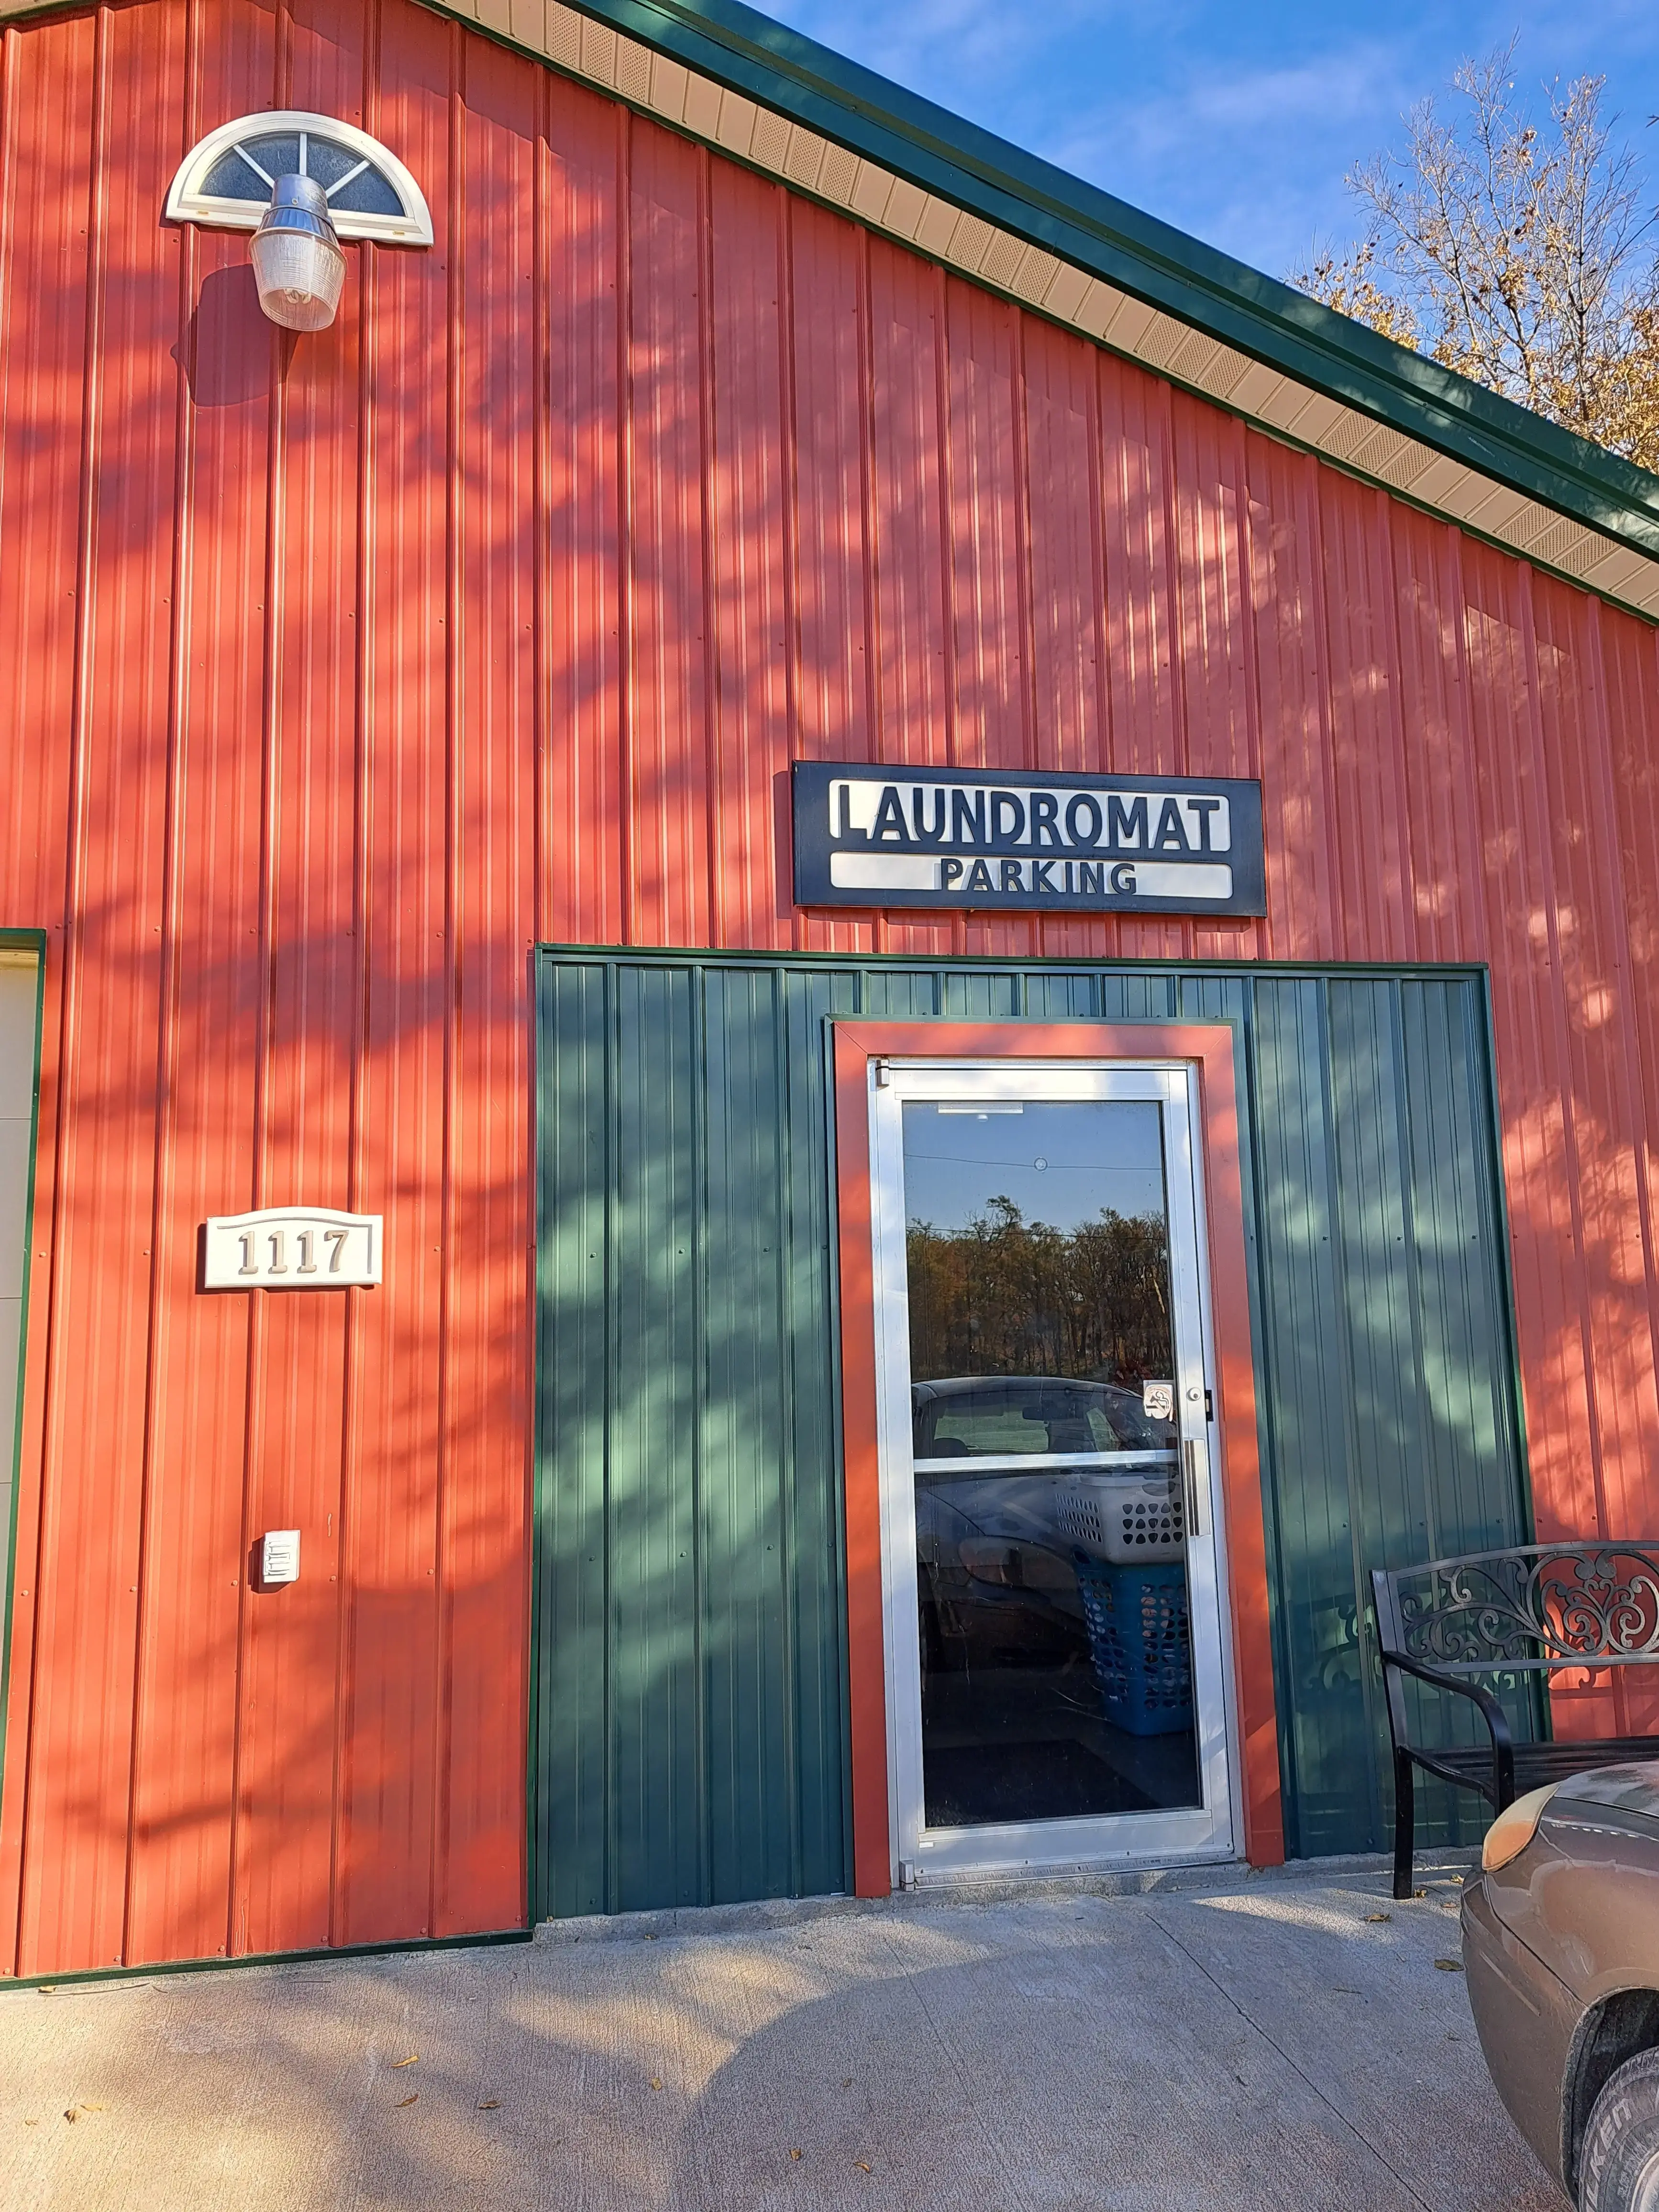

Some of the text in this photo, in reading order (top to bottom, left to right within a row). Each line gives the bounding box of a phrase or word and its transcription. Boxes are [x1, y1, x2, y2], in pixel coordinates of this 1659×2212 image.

[839, 784, 1220, 851] LAUNDROMAT
[941, 858, 1137, 895] PARKING
[238, 1230, 349, 1274] 1117
